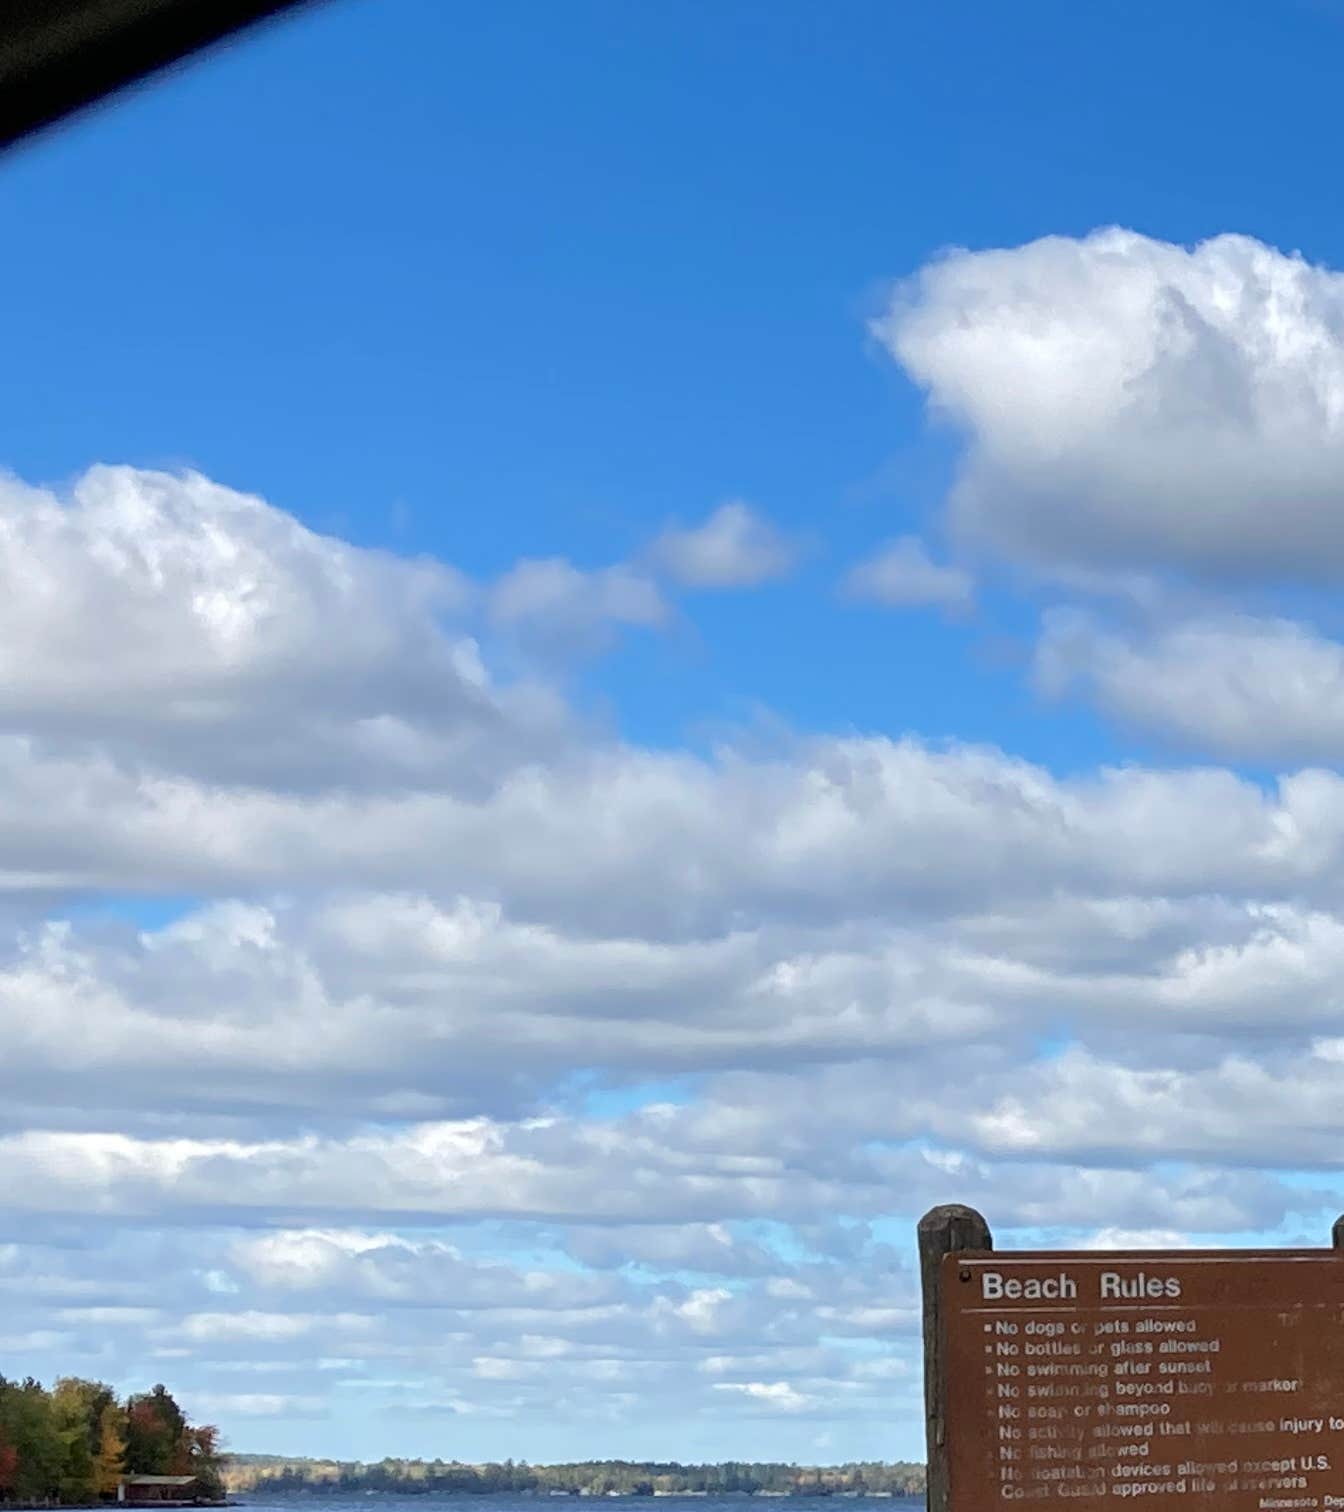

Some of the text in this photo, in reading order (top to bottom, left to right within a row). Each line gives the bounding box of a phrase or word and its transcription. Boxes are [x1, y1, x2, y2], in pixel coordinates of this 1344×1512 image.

[982, 1272, 1181, 1299] Beach Rules
[995, 1321, 1019, 1335] No
[1025, 1319, 1065, 1336] dogs
[1094, 1319, 1129, 1336] pets
[1135, 1318, 1196, 1333] allowed
[996, 1341, 1019, 1355] No
[1025, 1340, 1081, 1356] bottles
[1110, 1339, 1153, 1357] glass
[1159, 1338, 1220, 1354] allowed
[997, 1359, 1211, 1377] No swimming after sunset
[997, 1383, 1020, 1398] No
[1115, 1380, 1173, 1398] beyond
[999, 1404, 1020, 1418] No
[1074, 1405, 1090, 1418] or
[1097, 1402, 1170, 1418] shampoo
[1000, 1426, 1022, 1440] No
[1092, 1422, 1153, 1438] allowed
[1159, 1421, 1191, 1437] that
[1227, 1420, 1275, 1434] cause
[1280, 1416, 1323, 1435] injury
[1329, 1416, 1344, 1431] to
[1000, 1446, 1021, 1461] No
[1089, 1441, 1149, 1458] allowed
[1001, 1466, 1022, 1481] No
[1111, 1463, 1170, 1478] devices
[1177, 1459, 1237, 1475] allowed
[1243, 1457, 1296, 1475] except
[1301, 1455, 1332, 1471] U.S.
[1112, 1479, 1186, 1498] approved
[1192, 1477, 1216, 1492] life
[1259, 1496, 1318, 1509] Minnesota
